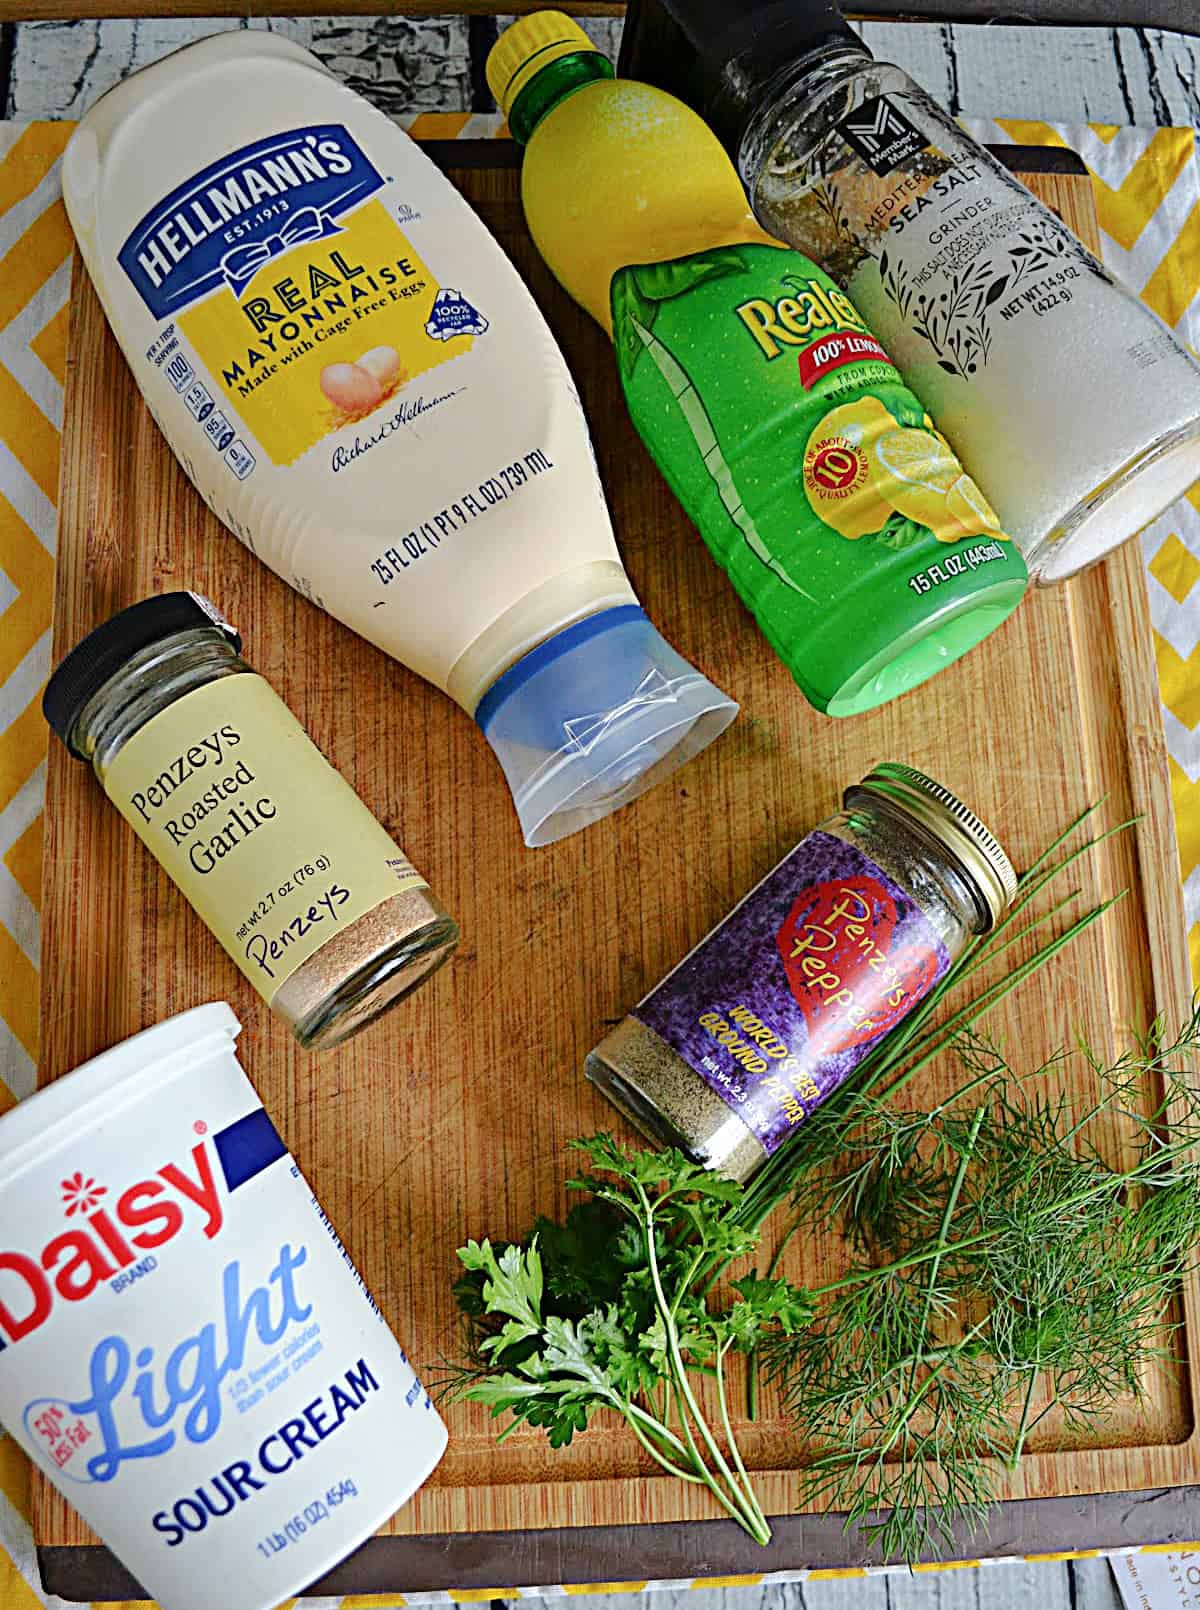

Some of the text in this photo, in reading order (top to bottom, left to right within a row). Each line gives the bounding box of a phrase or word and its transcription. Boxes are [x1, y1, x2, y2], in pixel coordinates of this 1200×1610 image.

[870, 130, 919, 166] Member's
[137, 135, 352, 288] HELLMANN'S
[889, 196, 934, 234] SEA
[933, 164, 982, 197] SALT
[929, 197, 993, 245] GRINDER
[242, 251, 365, 333] REAL
[911, 267, 932, 288] THIS
[927, 249, 948, 274] SALT
[944, 233, 970, 257] DOES
[221, 258, 416, 388] MAYONNAISE
[435, 304, 470, 316] 100%
[1000, 300, 1027, 321] NET
[1023, 282, 1046, 308] WT
[1040, 271, 1066, 292] 14.9
[1031, 287, 1073, 317] (422 g)
[167, 355, 188, 383] 100
[238, 279, 427, 398] Made with Cage Free Eggs
[812, 341, 846, 367] 100%
[817, 451, 853, 488] 10
[371, 558, 394, 585] 25
[385, 548, 410, 572] FL
[402, 532, 427, 559] OZ
[420, 523, 441, 548] (1
[433, 510, 458, 536] PT
[452, 504, 467, 523] 9
[461, 494, 487, 517] FL
[479, 478, 508, 505] OZ)
[500, 462, 528, 491] 739
[909, 577, 931, 596] 15
[928, 565, 951, 585] FL
[944, 555, 967, 575] OZ
[130, 724, 242, 825] Penzeys
[164, 760, 255, 846] Roasted
[188, 797, 277, 875] Garlic
[236, 854, 331, 942] net wt 2.7 oz (76 g)
[246, 884, 350, 978] Penzeys
[789, 924, 873, 1031] Pepper
[824, 887, 906, 1007] Penzeys
[698, 1012, 805, 1125] GROUND PEPPER
[701, 1056, 718, 1075] net
[790, 1071, 821, 1101] BEST
[0, 1141, 223, 1343] Daisy
[110, 1255, 159, 1294] BRAND
[66, 1243, 313, 1482] Light
[266, 1367, 289, 1392] sour
[291, 1341, 323, 1371] cream
[34, 1407, 63, 1445] 50%
[153, 1358, 380, 1546] SOUR CREAM
[257, 1542, 270, 1558] 1
[284, 1516, 307, 1543] (16
[304, 1500, 329, 1525] OZ)
